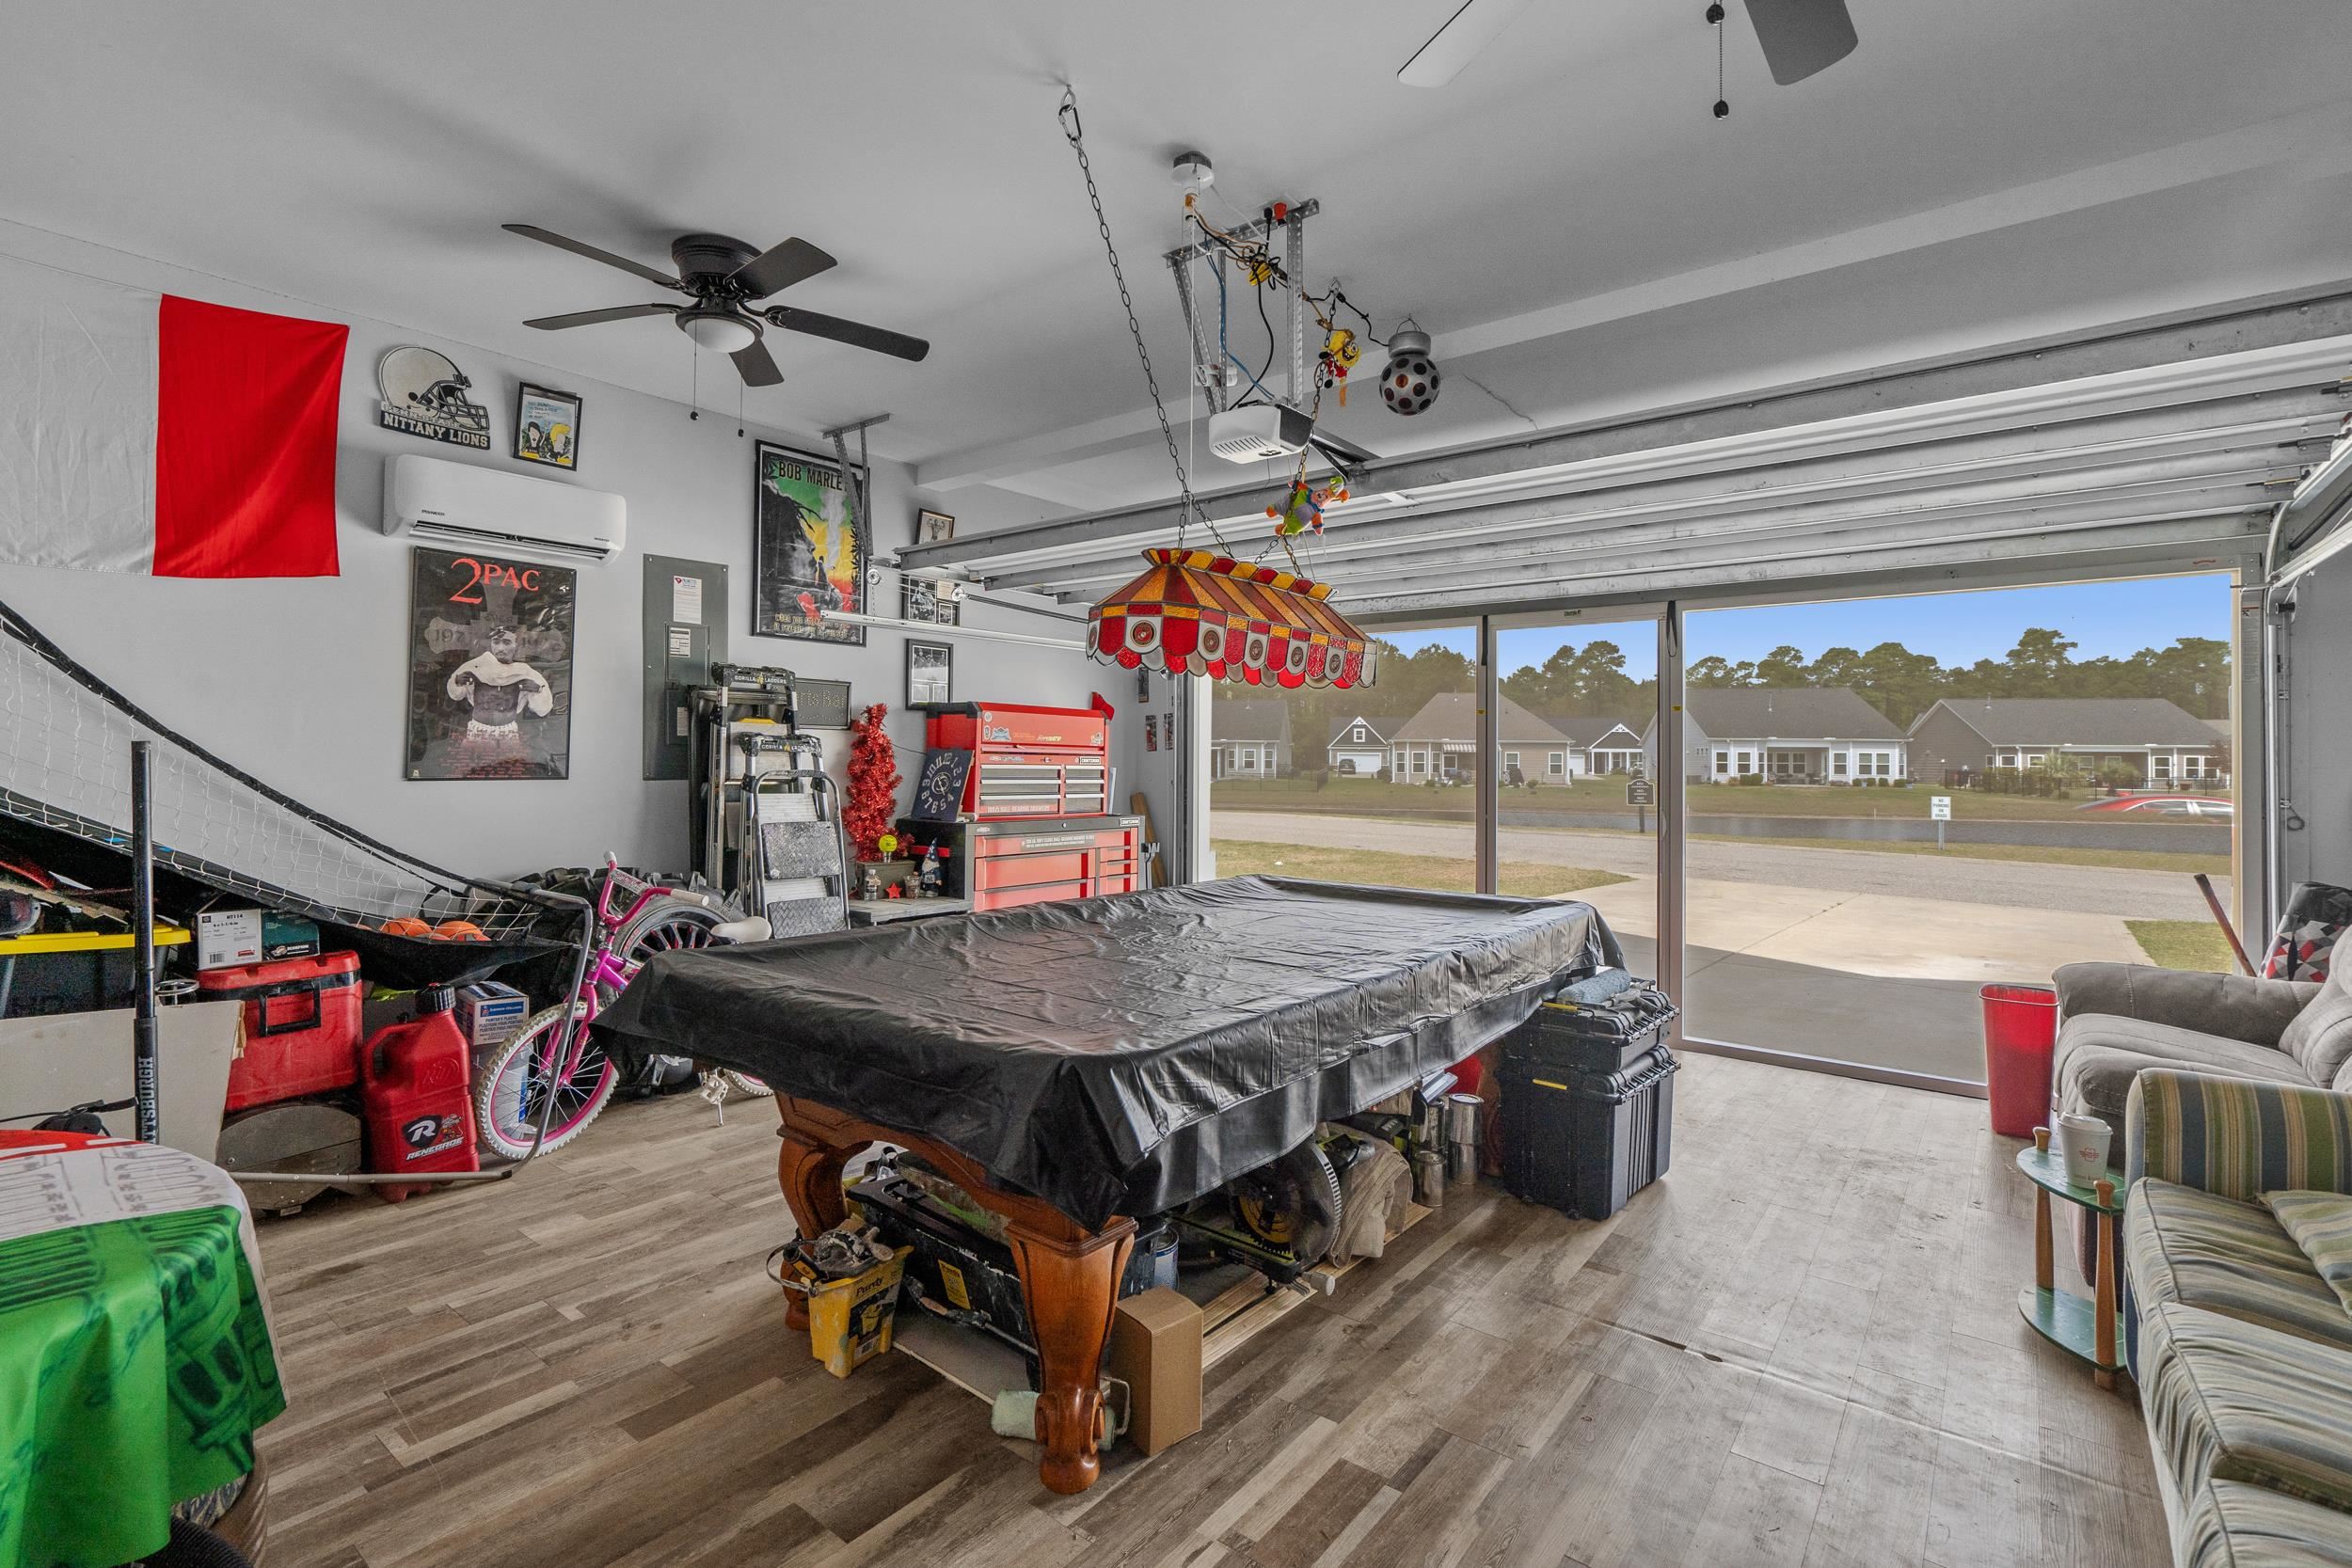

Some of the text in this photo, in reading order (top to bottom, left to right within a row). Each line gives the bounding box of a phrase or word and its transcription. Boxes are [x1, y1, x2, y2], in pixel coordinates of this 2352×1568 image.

[384, 412, 488, 448] NITTANY LIONS
[778, 460, 848, 493] BOB MARLE
[449, 558, 542, 605] 2PAC
[734, 674, 756, 683] GORILLA
[942, 752, 953, 765] 12
[927, 763, 938, 779] 10
[921, 790, 930, 800] 8
[931, 800, 939, 814] 6
[405, 1136, 465, 1161] RENEGADE
[855, 1275, 884, 1297] Purdy
